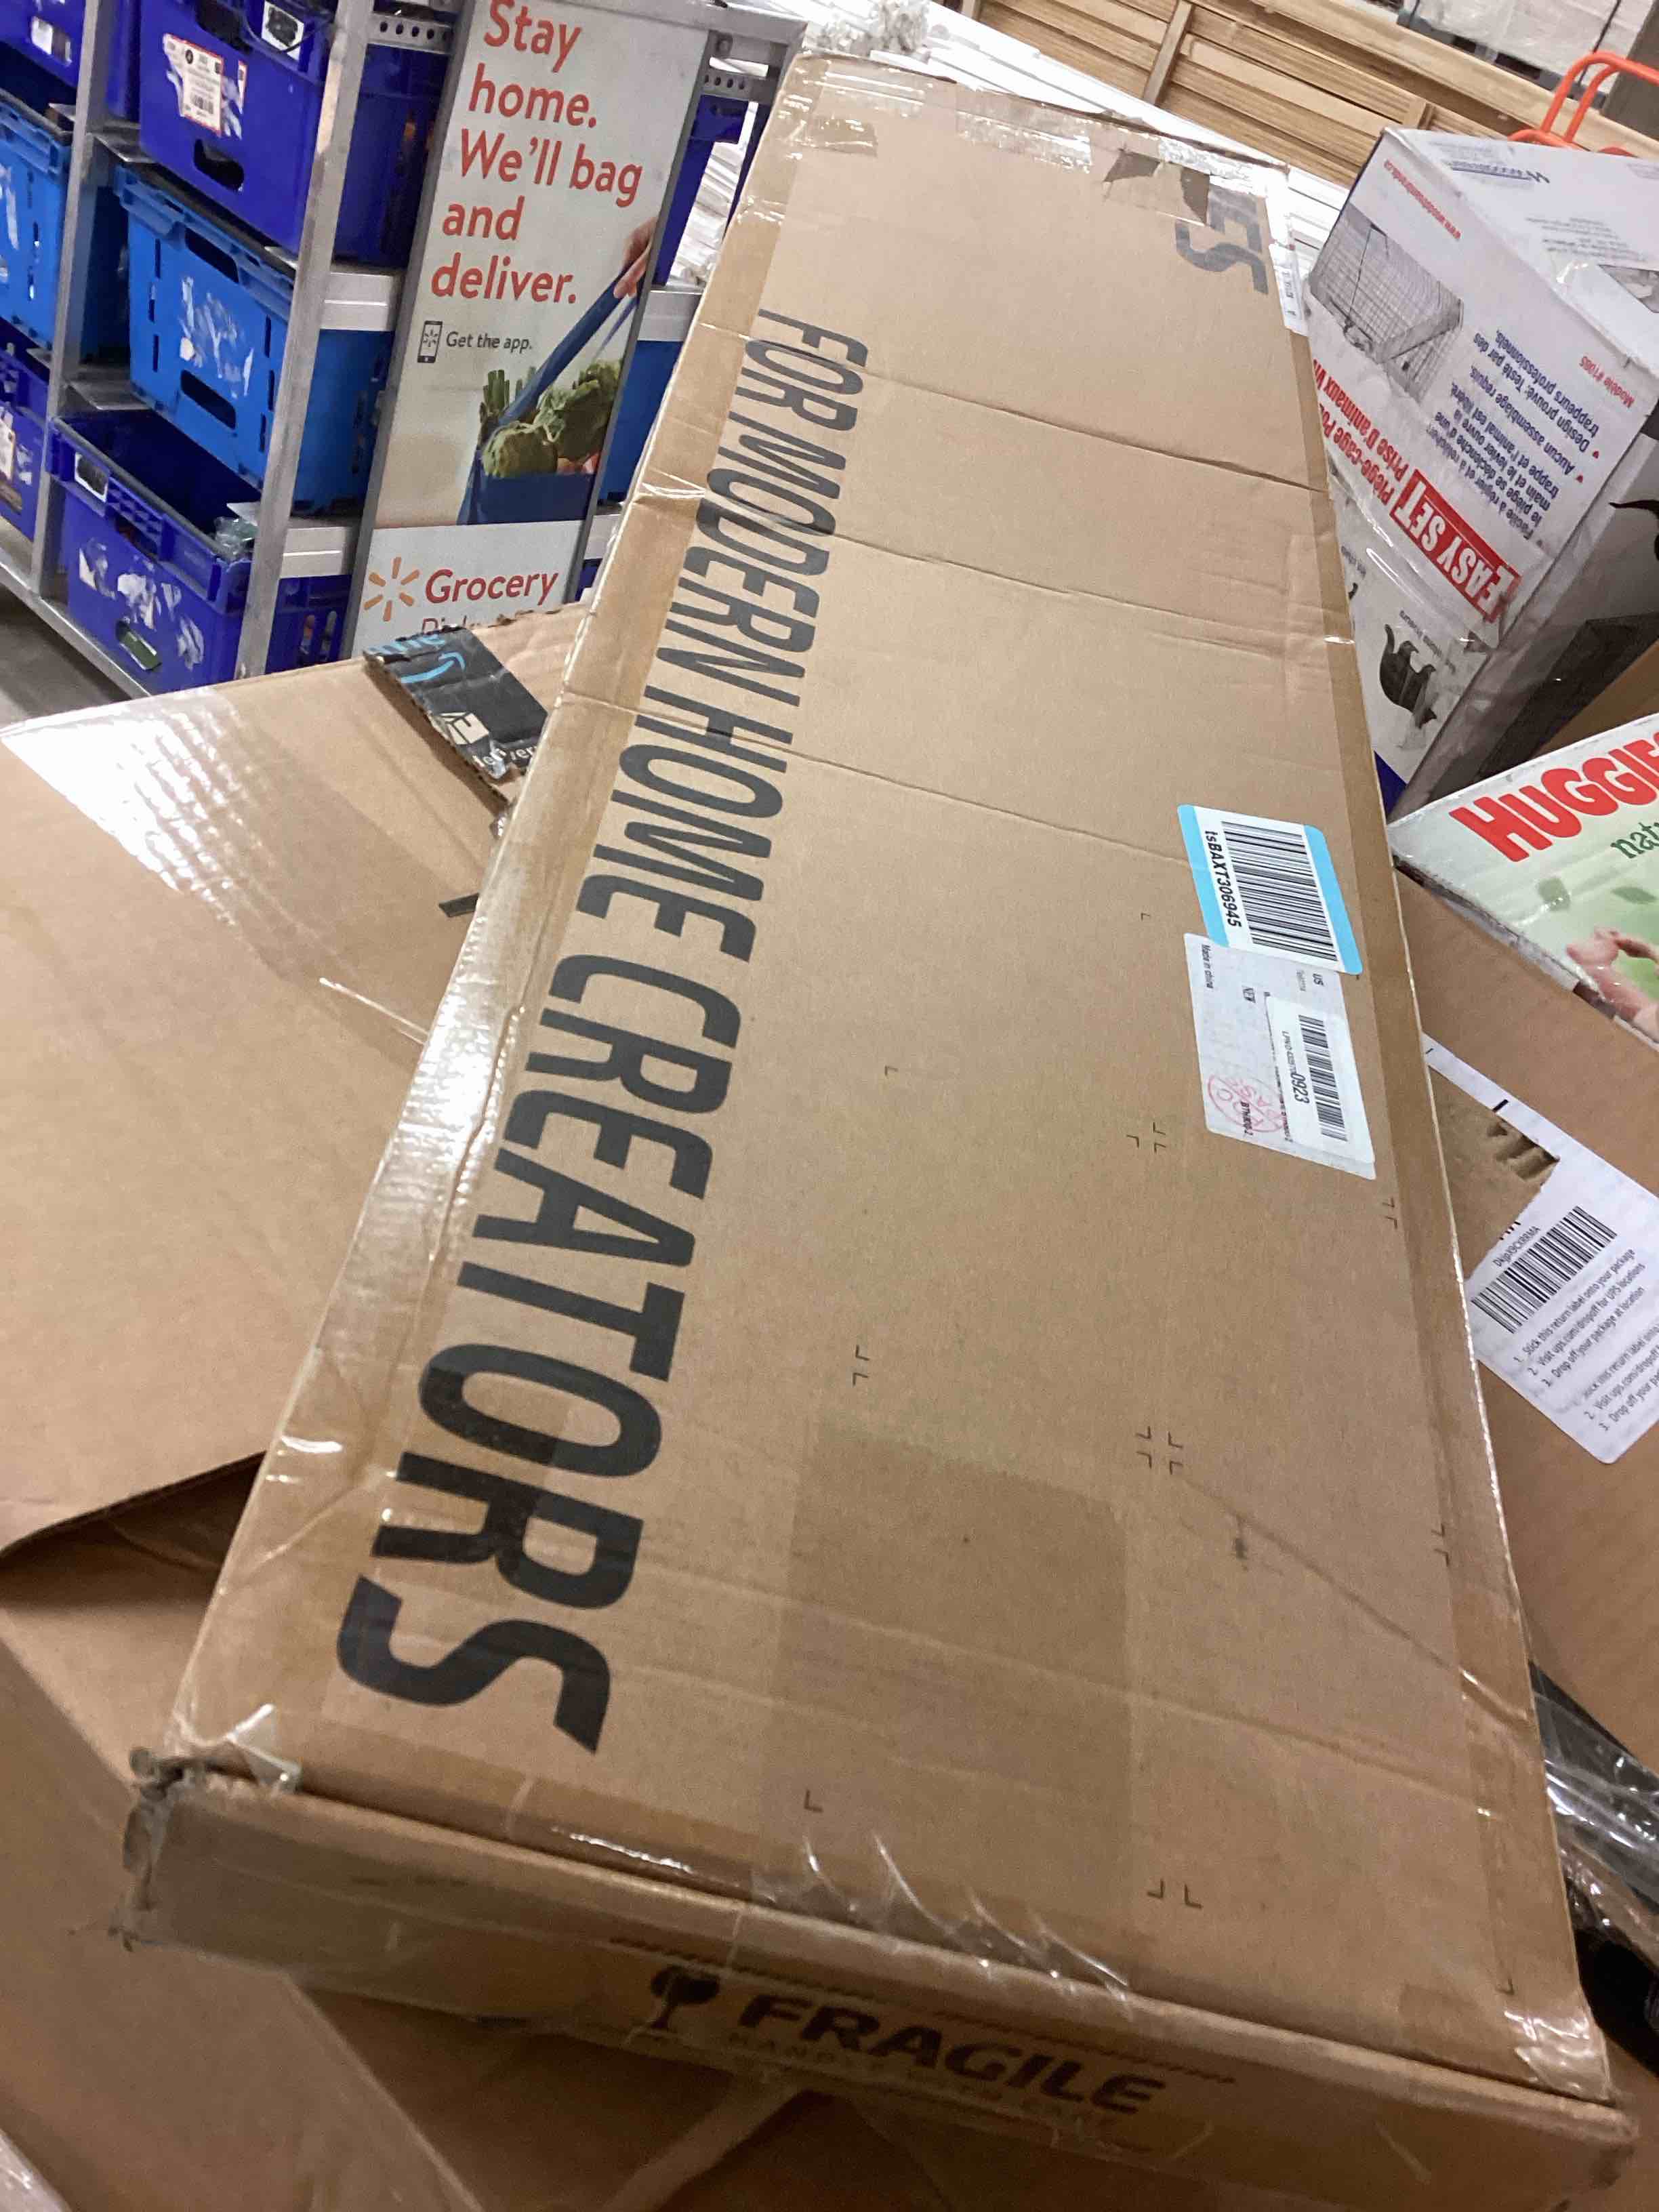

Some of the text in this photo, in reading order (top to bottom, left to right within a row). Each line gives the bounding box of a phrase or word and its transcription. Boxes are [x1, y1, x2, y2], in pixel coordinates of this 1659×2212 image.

[483, 0, 582, 73] Stay
[469, 63, 598, 127] home.
[460, 128, 643, 208] We'll bag
[442, 196, 525, 241] and
[430, 254, 578, 305] deliver.
[445, 330, 533, 355] Get the app.
[1471, 331, 1490, 355] des
[1487, 345, 1505, 367] par
[1319, 401, 1336, 440] Po
[1492, 389, 1547, 449] assemblage
[1551, 386, 1600, 438] trappeurs
[1555, 413, 1591, 454] Design
[1372, 435, 1412, 483] Prise
[1526, 462, 1560, 501] trappe
[1541, 440, 1575, 478] Aucun
[1393, 476, 1456, 554] SET
[1523, 483, 1551, 514] main
[424, 568, 559, 609] Grocery
[1435, 521, 1516, 617] EASY
[1449, 731, 1659, 863] HUGGIE
[1610, 821, 1659, 859] nat
[335, 308, 869, 1755] FOR MODERN HOME CREATORS
[737, 1992, 1166, 2115] FRAGILE
